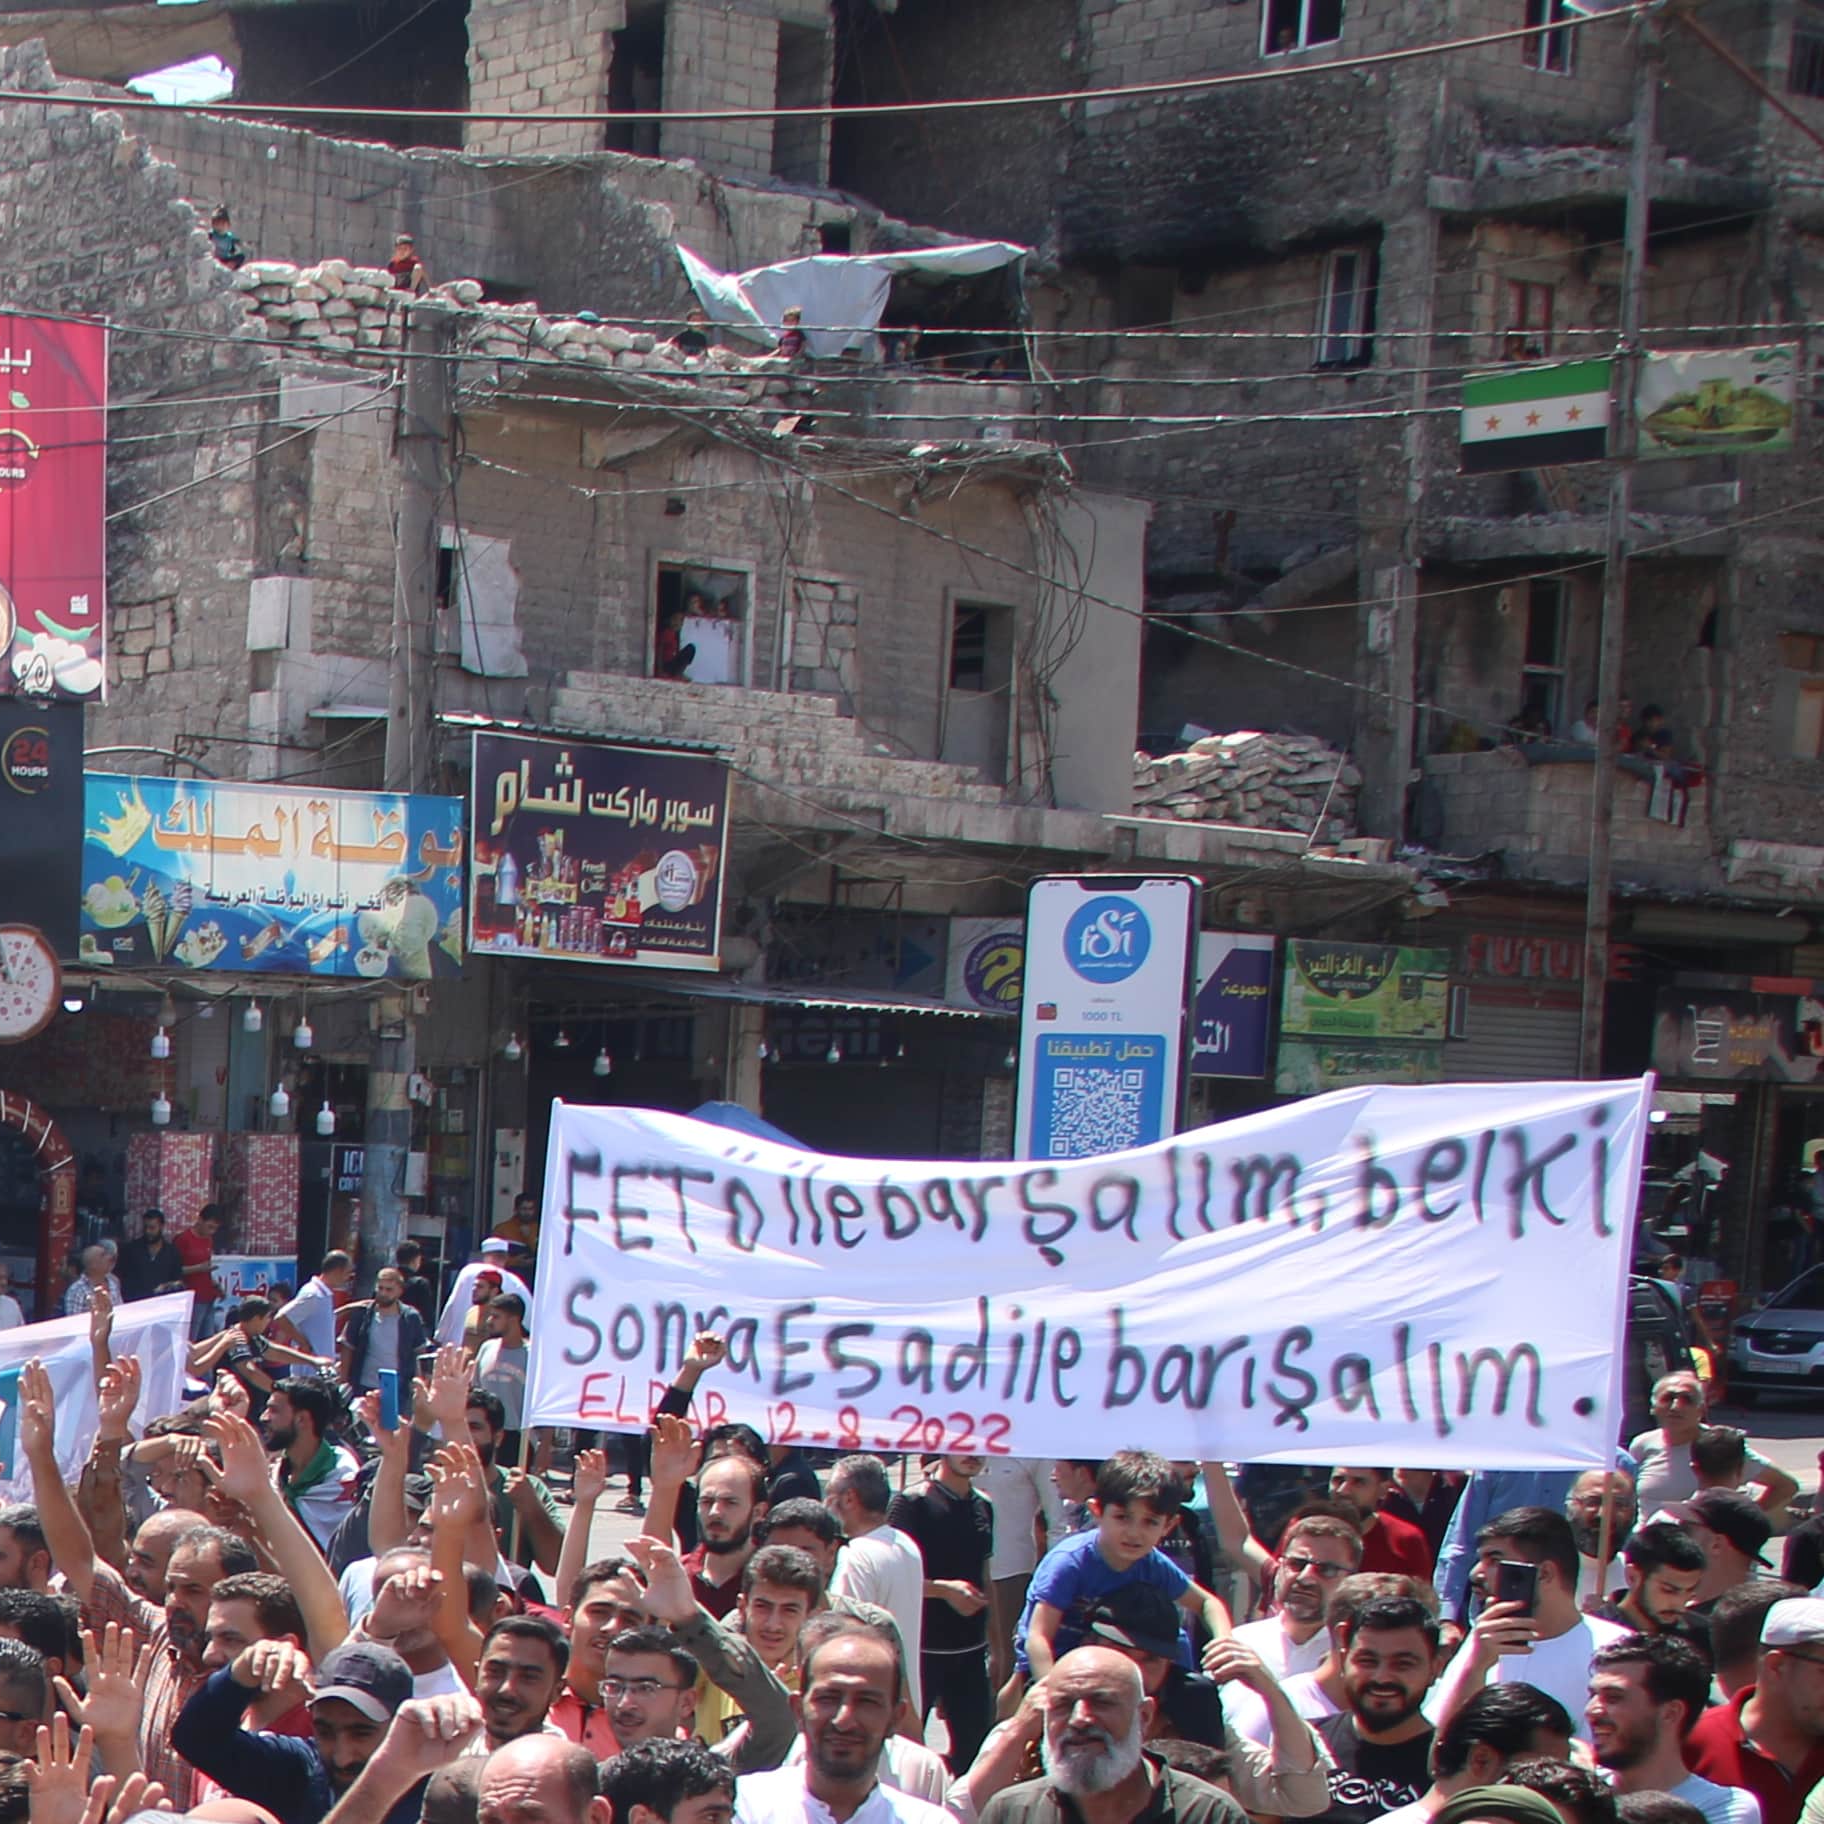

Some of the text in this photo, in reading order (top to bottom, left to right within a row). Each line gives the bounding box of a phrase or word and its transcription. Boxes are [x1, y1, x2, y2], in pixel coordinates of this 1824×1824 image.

[12, 739, 49, 764] 24
[10, 764, 50, 777] HOURS
[491, 751, 584, 836] شام
[587, 788, 714, 833] سوبر ماركت
[153, 797, 464, 888] بوظة الملك
[204, 882, 262, 908] العربية
[1467, 933, 1635, 981] FUTUE
[1082, 1012, 1123, 1022] 1000 TL
[1046, 1040, 1155, 1060] حمل تطبيقنا
[562, 1146, 765, 1255] FETÖ
[1353, 1102, 1614, 1239] belki
